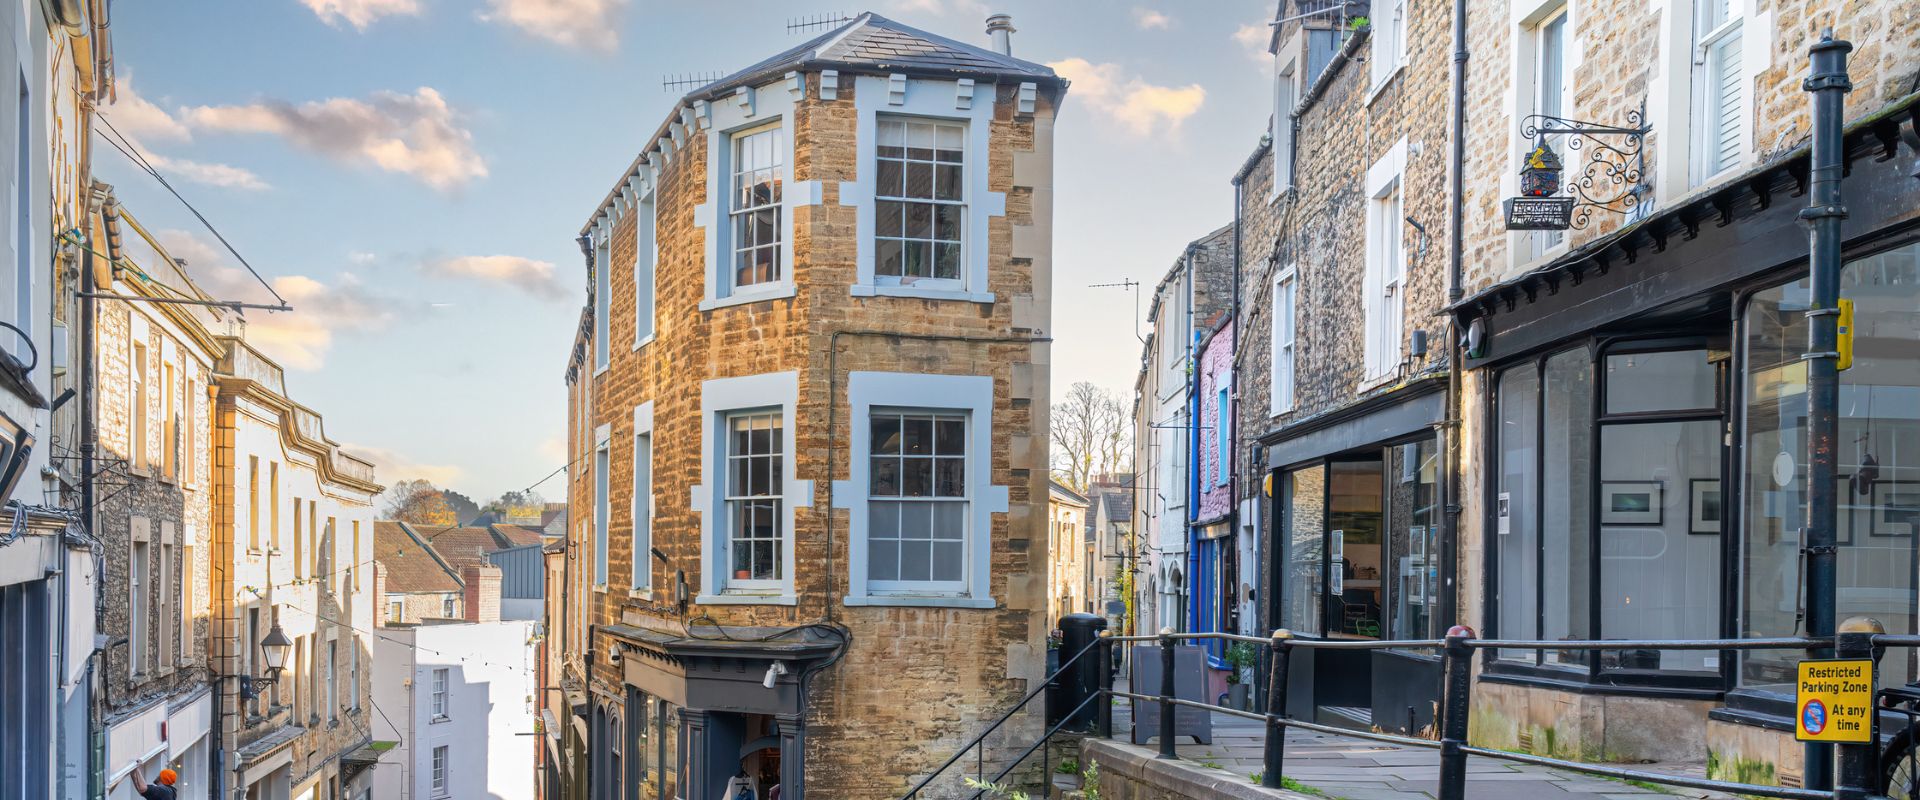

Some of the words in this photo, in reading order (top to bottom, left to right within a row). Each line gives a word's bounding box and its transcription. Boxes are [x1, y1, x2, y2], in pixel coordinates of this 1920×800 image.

[1808, 666, 1861, 678] Restricted
[1801, 682, 1839, 695] Parking
[1842, 681, 1868, 693] Zone
[1832, 704, 1845, 716] At
[1847, 706, 1866, 718] any
[1837, 719, 1860, 731] time
